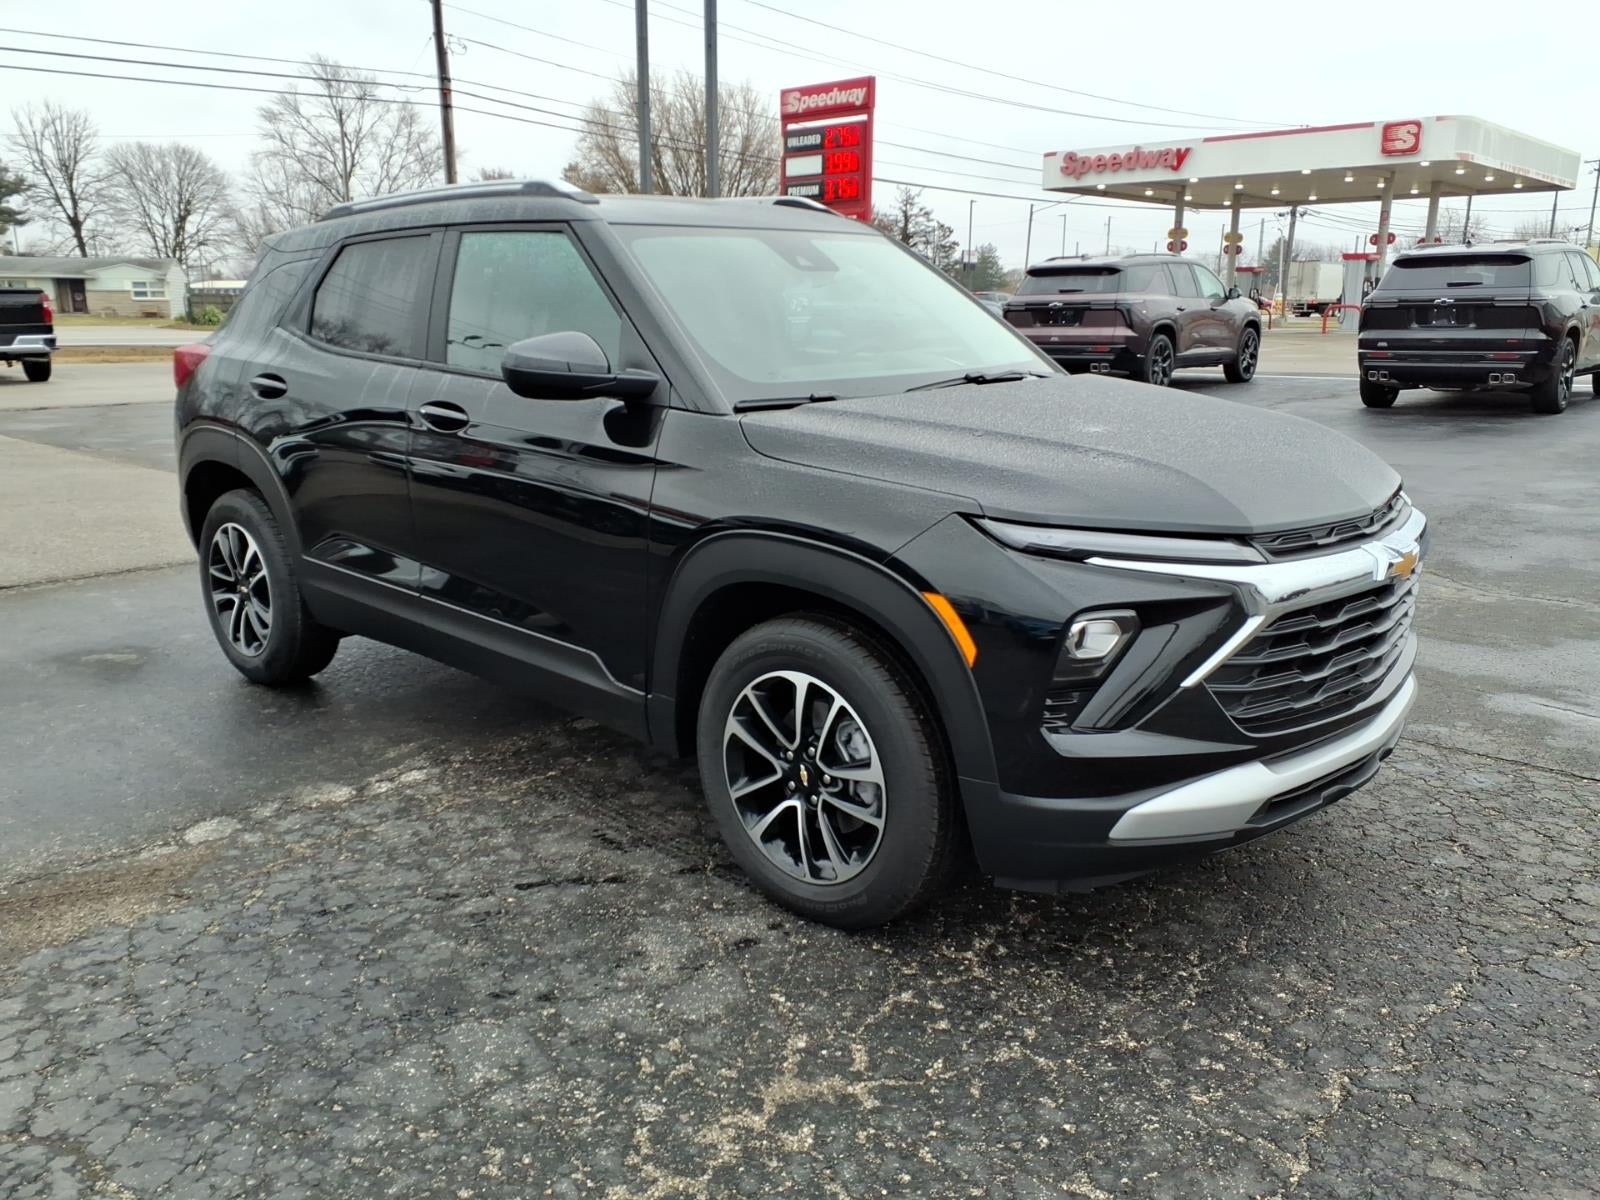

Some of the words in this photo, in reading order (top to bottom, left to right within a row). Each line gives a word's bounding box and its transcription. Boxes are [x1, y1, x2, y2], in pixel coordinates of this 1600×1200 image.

[782, 87, 867, 113] Speedway
[787, 134, 822, 148] UNLEADED
[1383, 124, 1419, 150] S
[1060, 146, 1192, 180] Speedway
[788, 185, 820, 196] PREMIUM
